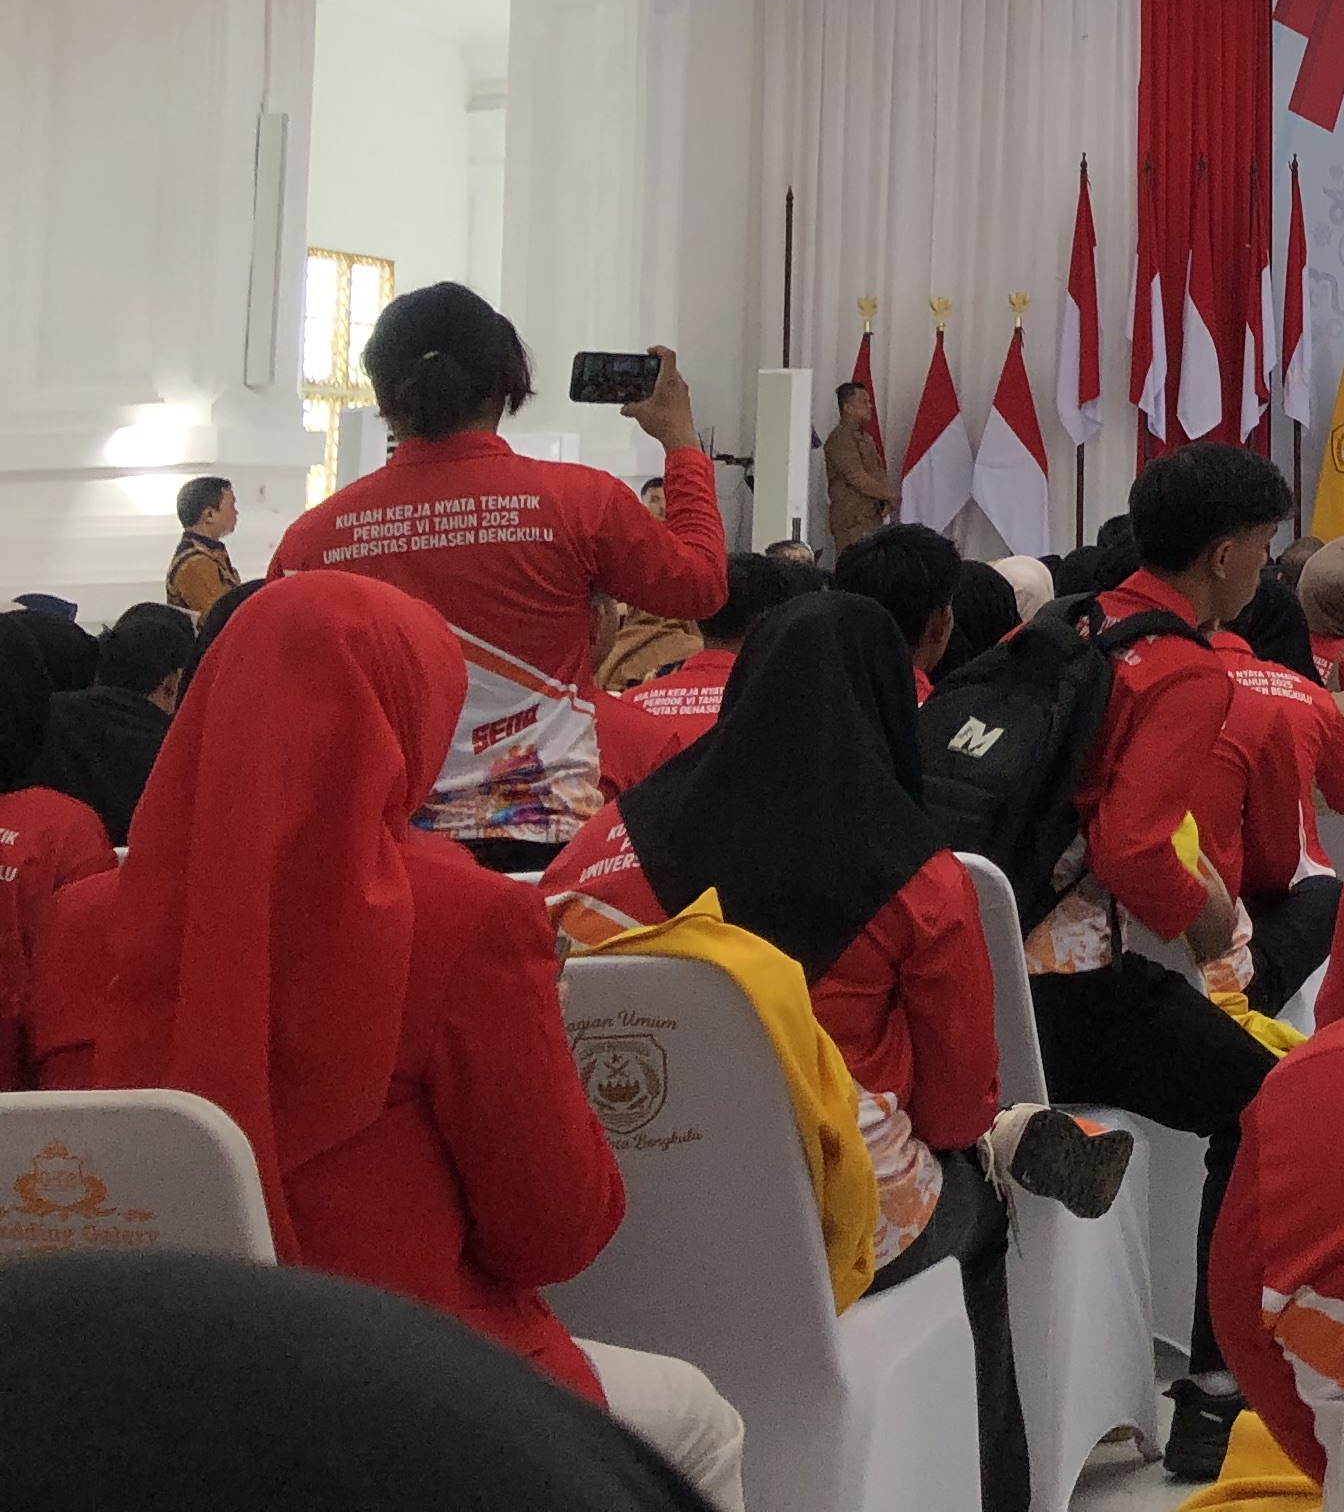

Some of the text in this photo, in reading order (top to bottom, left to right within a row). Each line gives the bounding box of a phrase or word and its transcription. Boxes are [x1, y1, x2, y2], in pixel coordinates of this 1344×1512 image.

[335, 494, 541, 530] KULIAH KERJA NYATA TEMATIK
[353, 510, 520, 542] PERIODE VI TAHUN 2025
[322, 527, 554, 566] UNIVERSITAS DEHASEN BENGKULU
[566, 1015, 615, 1037] agian
